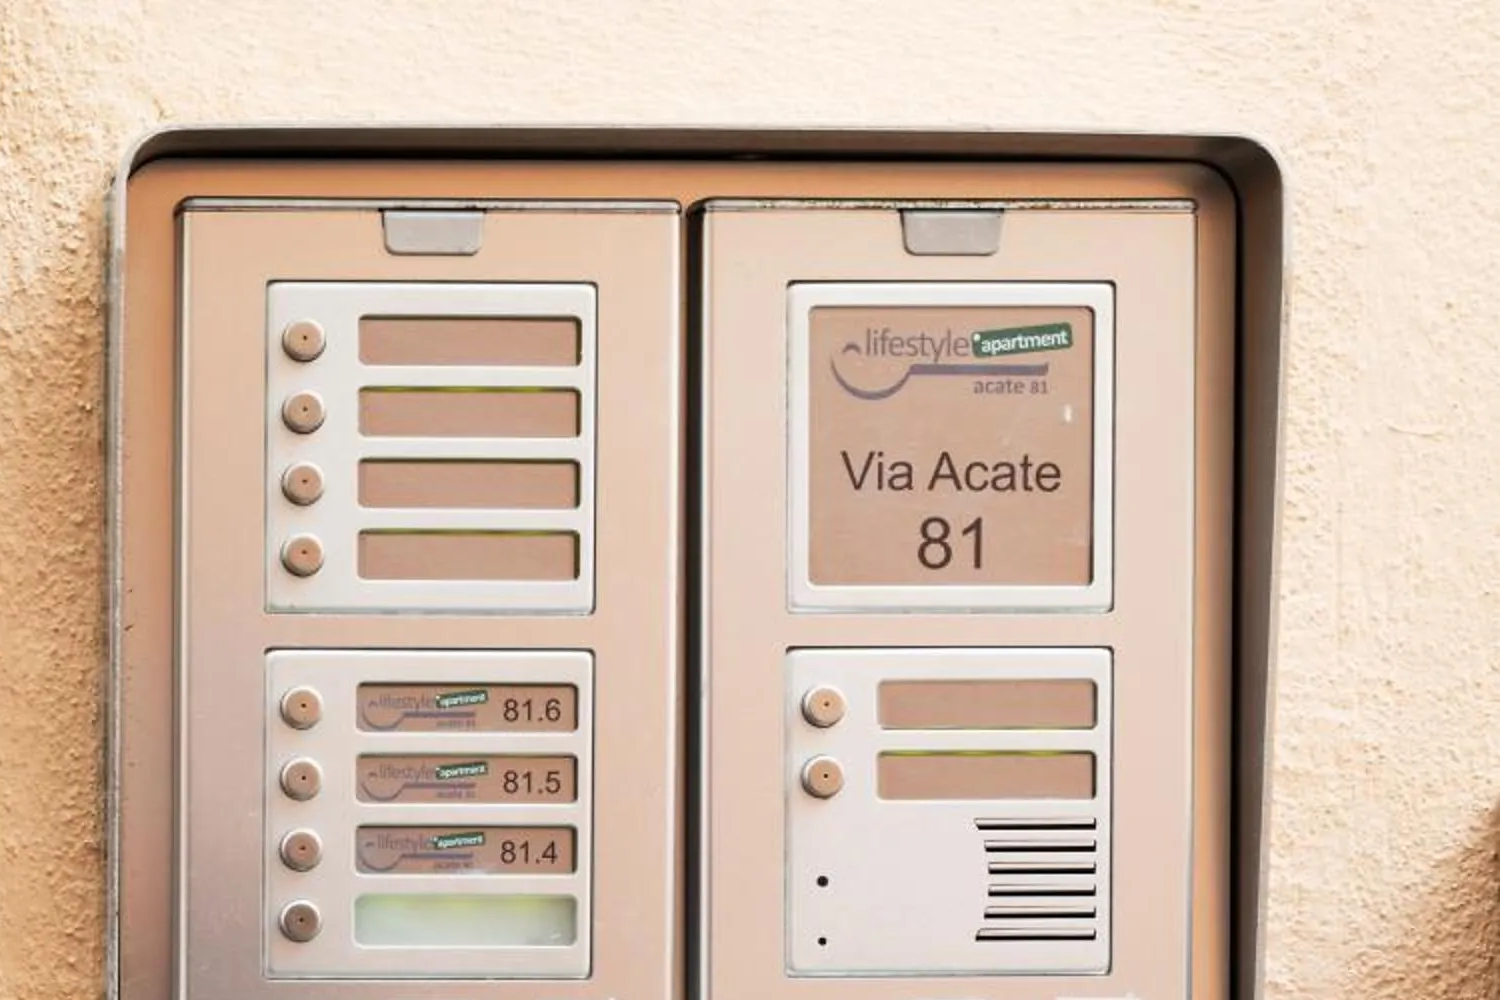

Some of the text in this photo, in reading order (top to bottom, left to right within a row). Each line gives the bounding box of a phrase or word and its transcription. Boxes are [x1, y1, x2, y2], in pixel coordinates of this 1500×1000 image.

[866, 328, 1069, 363] lifestyle apartment
[973, 379, 1049, 395] acate 81
[840, 450, 1061, 492] Via Acate
[917, 516, 984, 570] 81
[438, 691, 486, 708] apartment
[503, 698, 561, 722] 81.6
[438, 763, 486, 779] apartment
[503, 770, 561, 794] 81.5
[437, 834, 483, 850] apartment
[501, 840, 558, 865] 81.4
